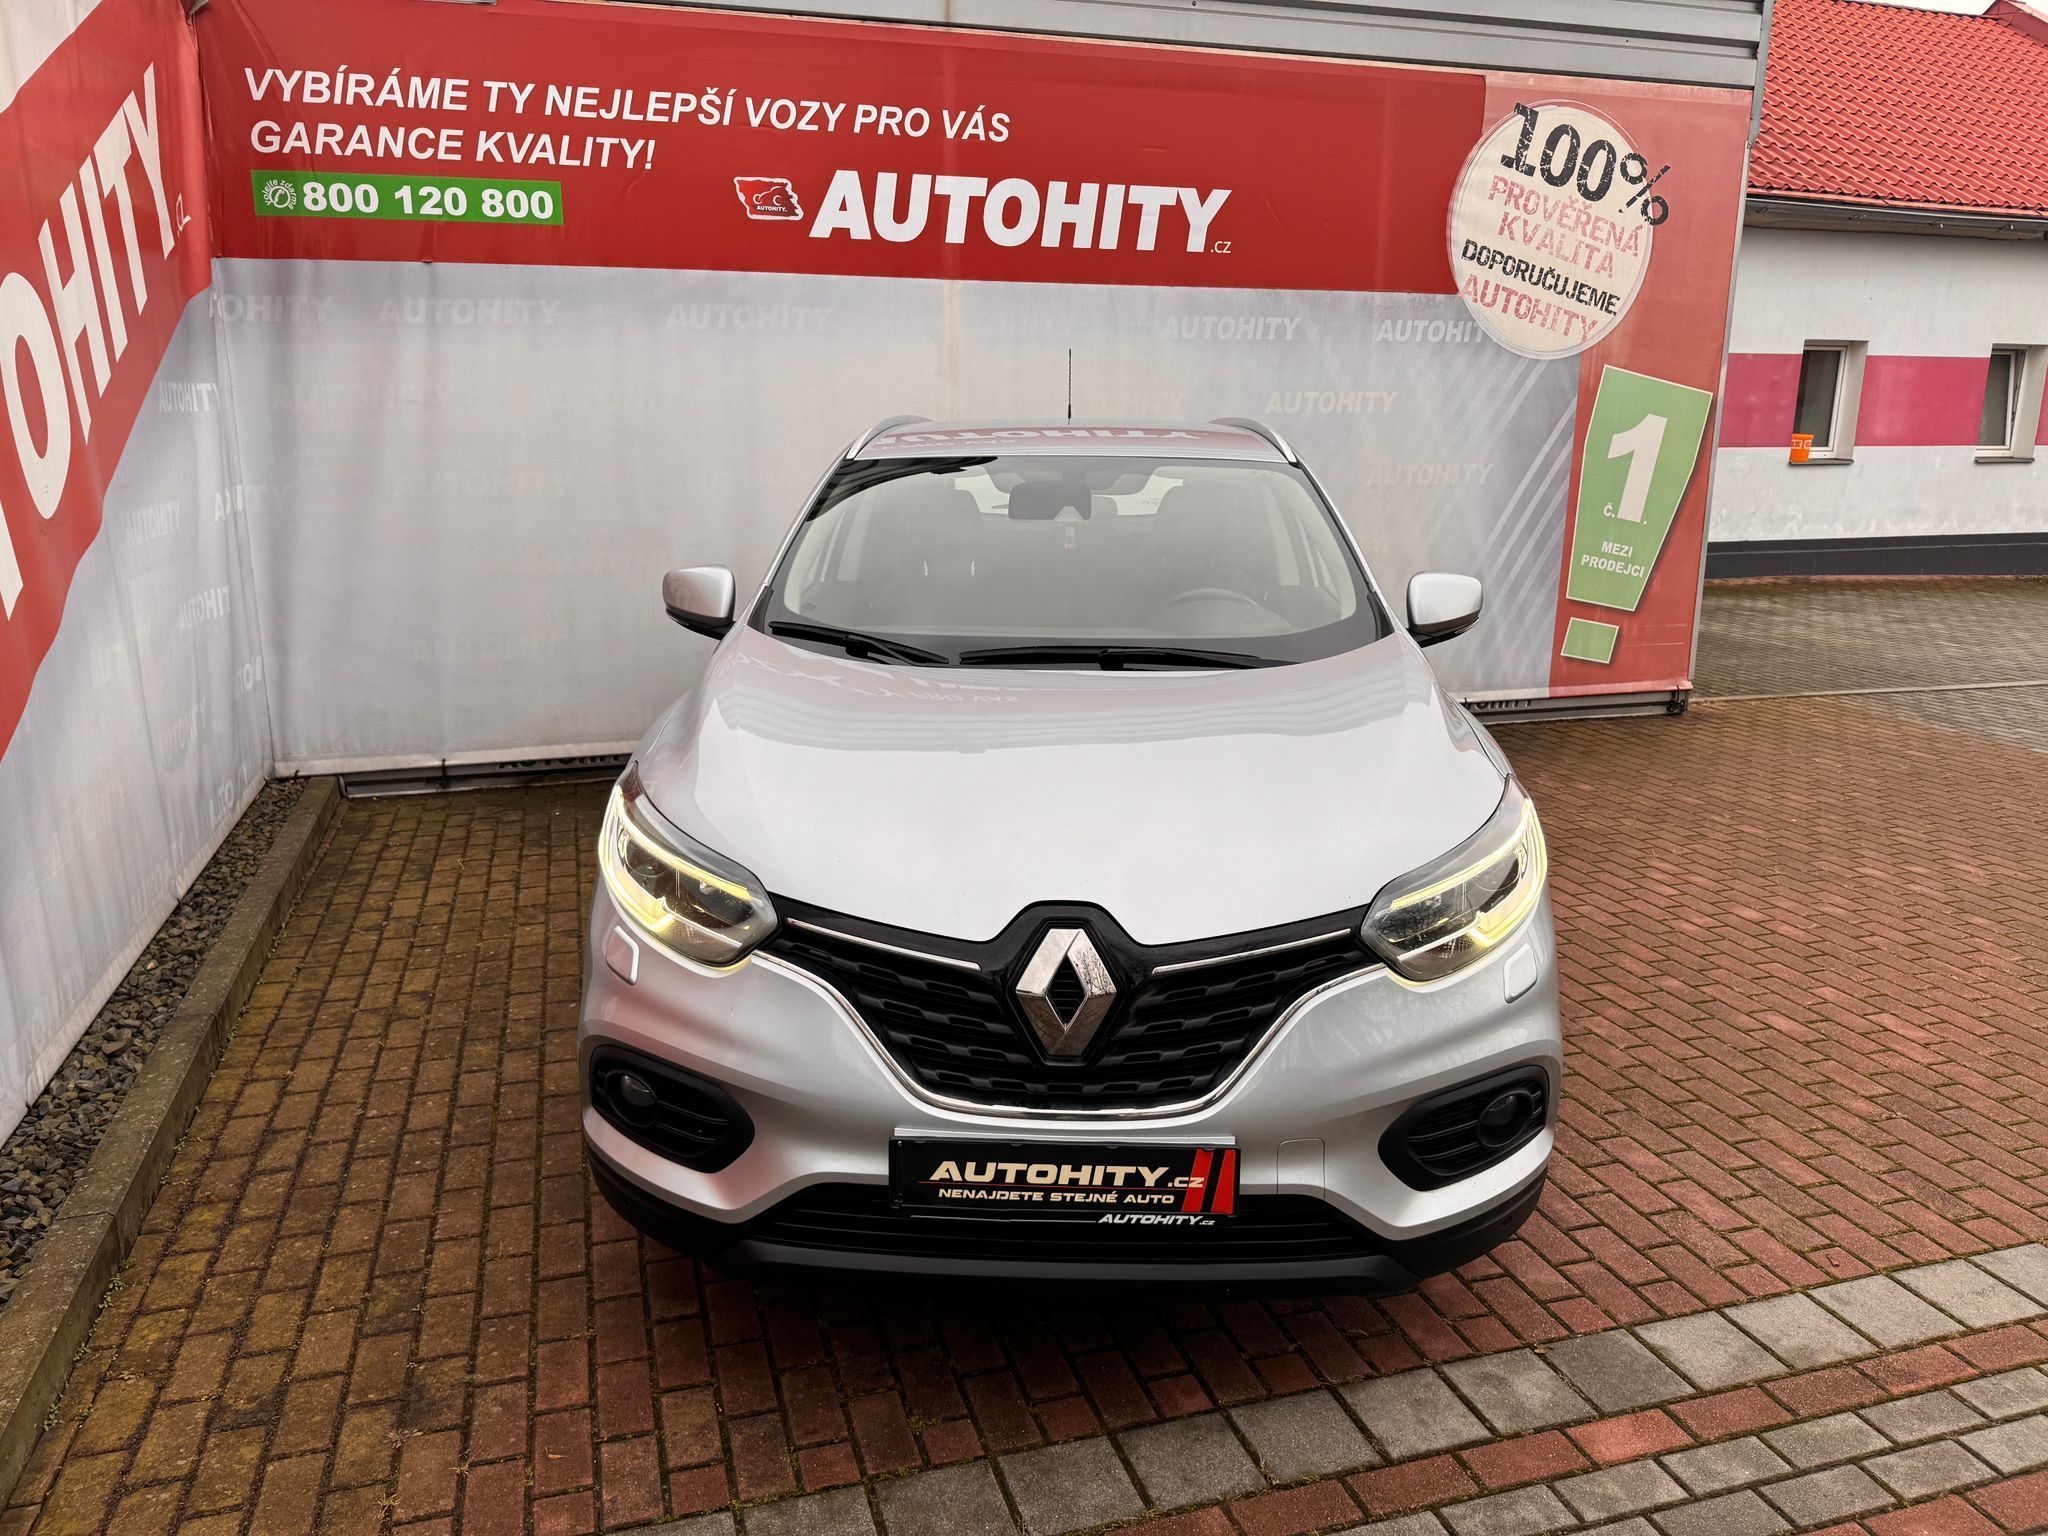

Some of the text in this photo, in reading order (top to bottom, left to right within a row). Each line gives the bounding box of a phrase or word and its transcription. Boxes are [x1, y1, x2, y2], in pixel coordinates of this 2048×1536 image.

[244, 64, 1011, 142] VYBÍRÁME TY NEJLEPŠÍ VOZY PRO VÁS
[250, 119, 656, 170] GARANCE KVALITY!
[1500, 102, 1671, 226] 100%
[262, 179, 297, 210] volejte zdarma
[302, 181, 554, 219] 800 120 800
[1488, 174, 1643, 257] PROVĚŘENÁ
[1497, 211, 1615, 279] KVALITA
[1461, 238, 1621, 316] DOPORUČUJEME
[378, 297, 564, 327] AUTOHITY
[666, 302, 837, 333] AUTOHITY
[1458, 273, 1598, 344] AUTOHITY
[1163, 315, 1301, 341] AUTOHITY
[1376, 319, 1493, 344] AUTOHIT
[1264, 390, 1398, 415] AUTOHITY
[1364, 463, 1495, 487] AUTOHITY
[1601, 540, 1634, 558] MEZI
[1580, 554, 1646, 578] PRODEJCI
[179, 585, 230, 634] AUTOHIT
[938, 1188, 1175, 1204] NENAJDETE STEJNÉ AUTO
